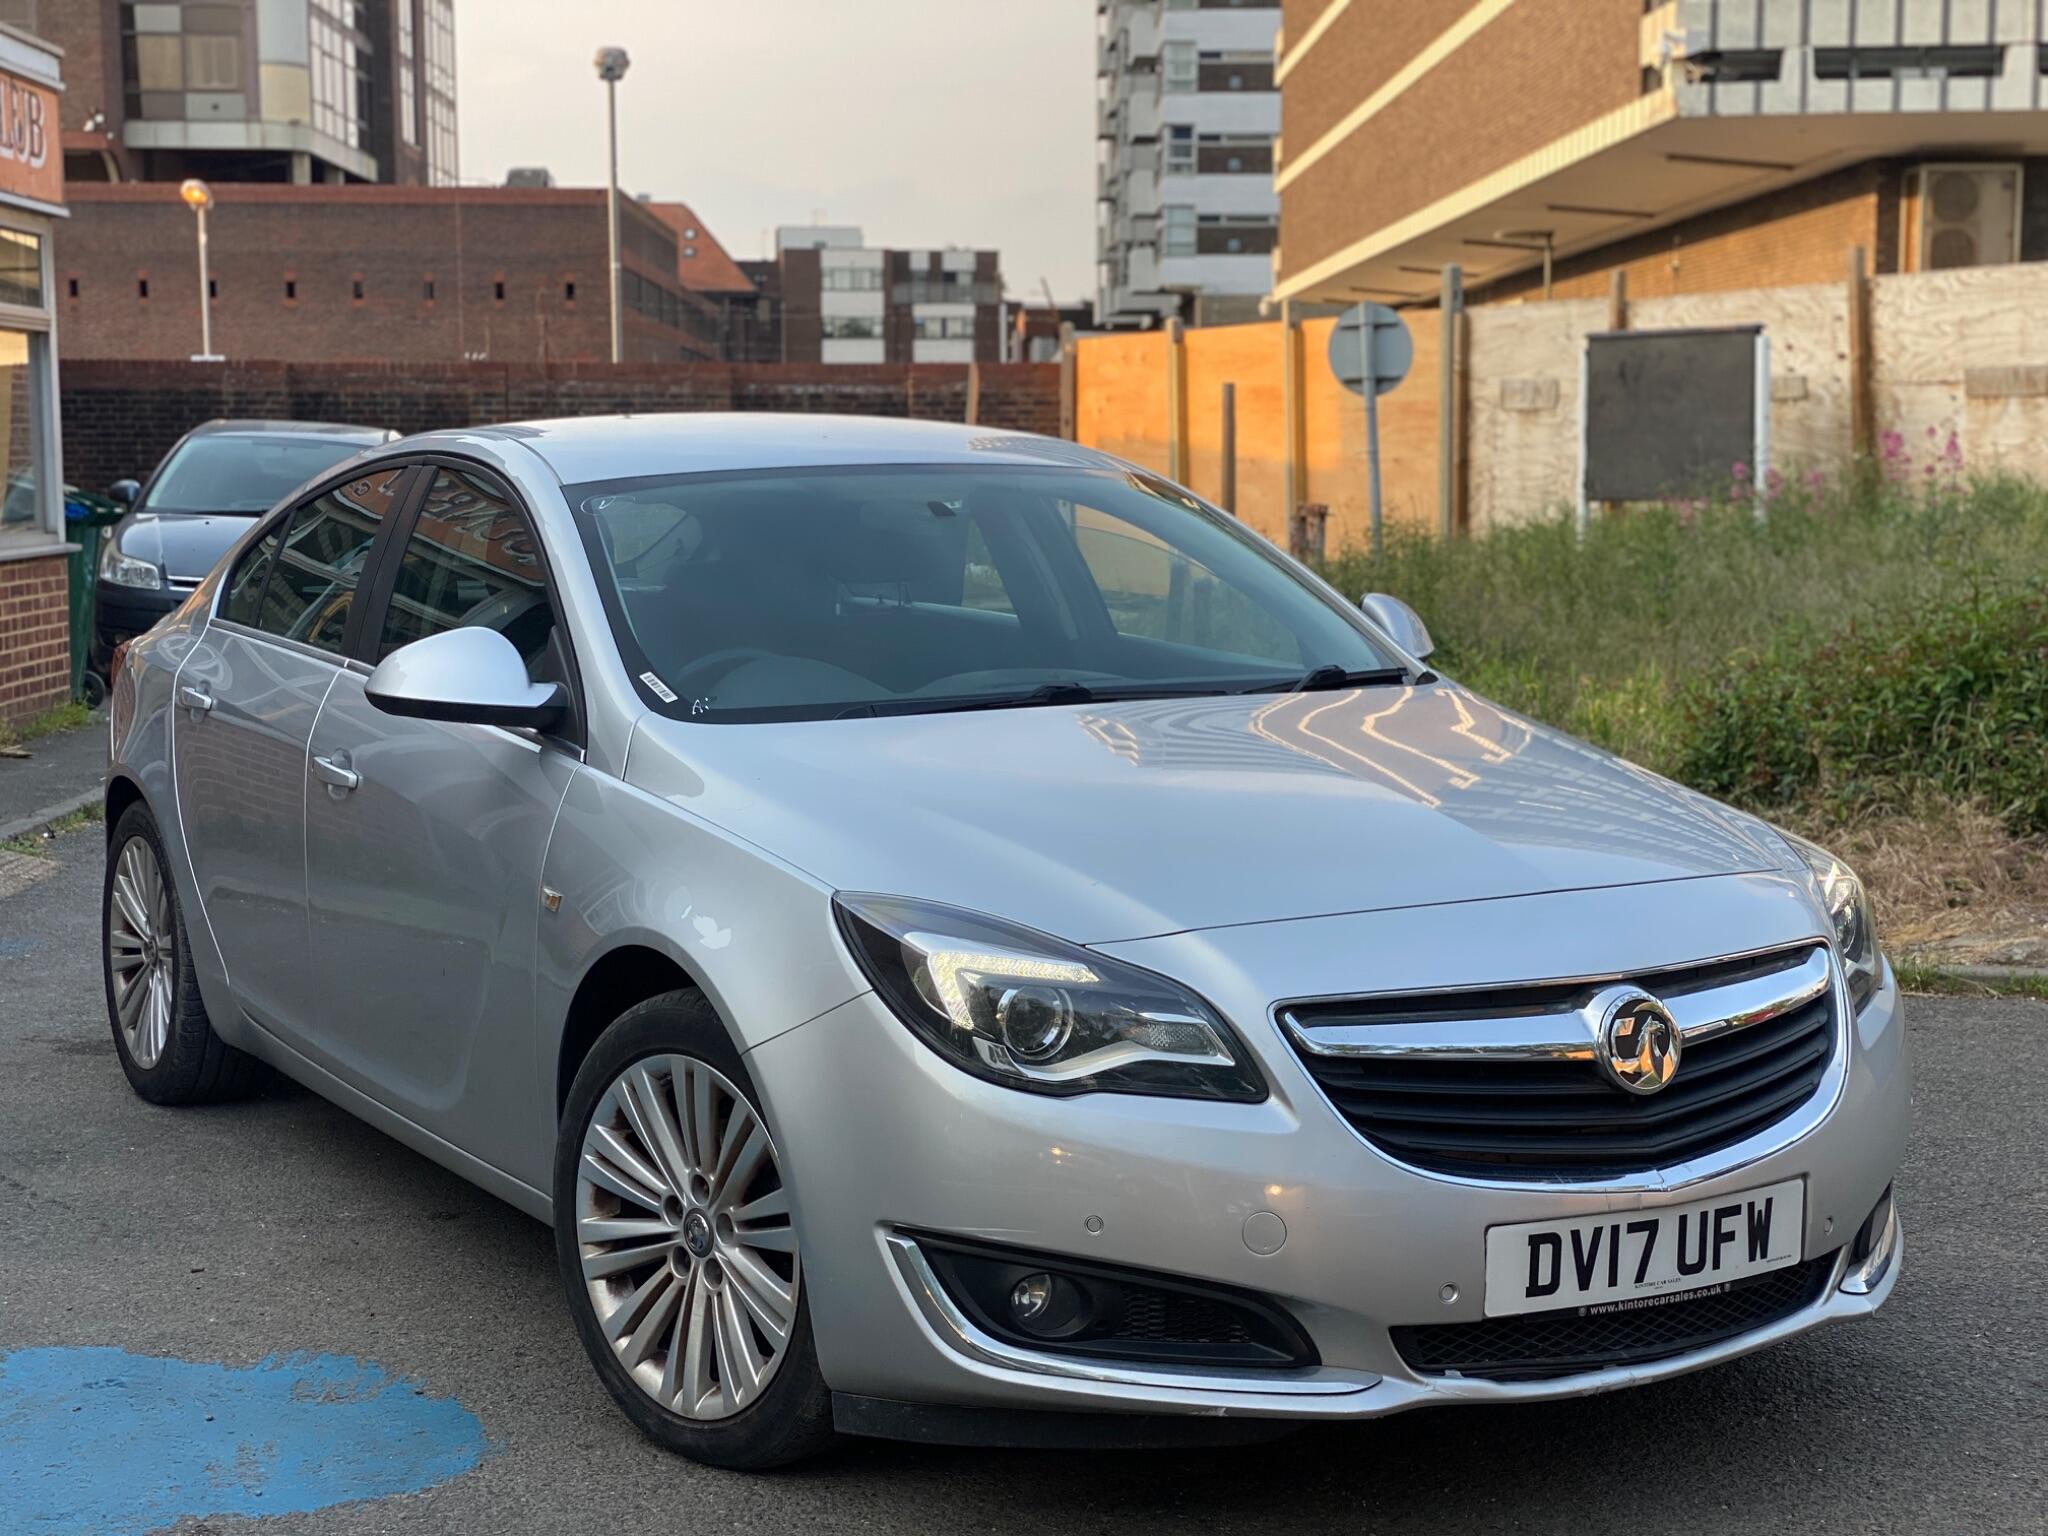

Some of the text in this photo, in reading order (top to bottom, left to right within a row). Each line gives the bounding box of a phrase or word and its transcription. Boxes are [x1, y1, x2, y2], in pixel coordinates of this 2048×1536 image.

[1525, 1197, 1774, 1298] DV17 UFW
[1590, 1285, 1722, 1315] www.kintorecarsales.co.uk
